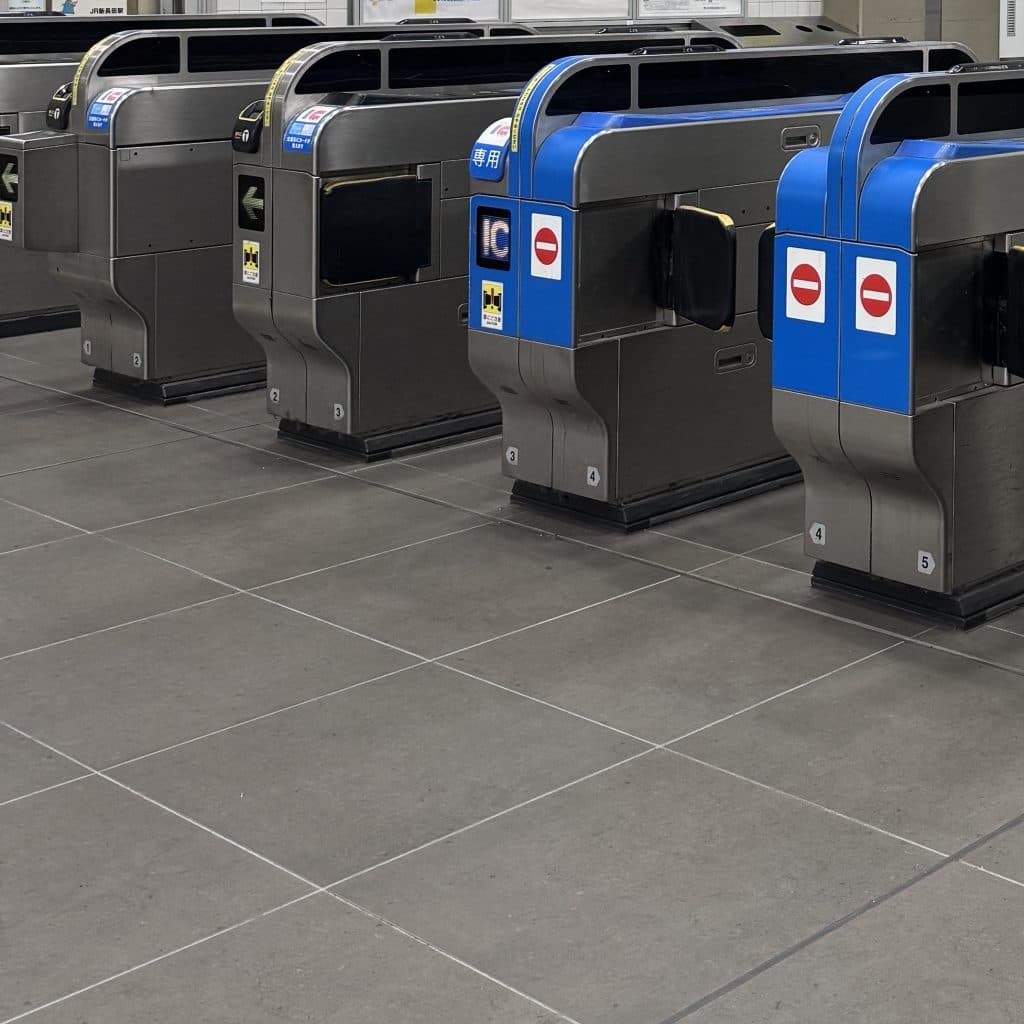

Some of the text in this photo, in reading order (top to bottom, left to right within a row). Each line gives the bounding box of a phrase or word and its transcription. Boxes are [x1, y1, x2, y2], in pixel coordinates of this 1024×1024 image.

[472, 148, 501, 169] 専用
[480, 218, 510, 258] IC
[85, 343, 90, 353] 1
[134, 356, 139, 366] 2
[272, 391, 278, 402] 2
[335, 407, 341, 417] 3
[509, 450, 516, 461] 3
[589, 470, 596, 482] 4
[815, 527, 823, 541] 4
[921, 555, 929, 570] 5
